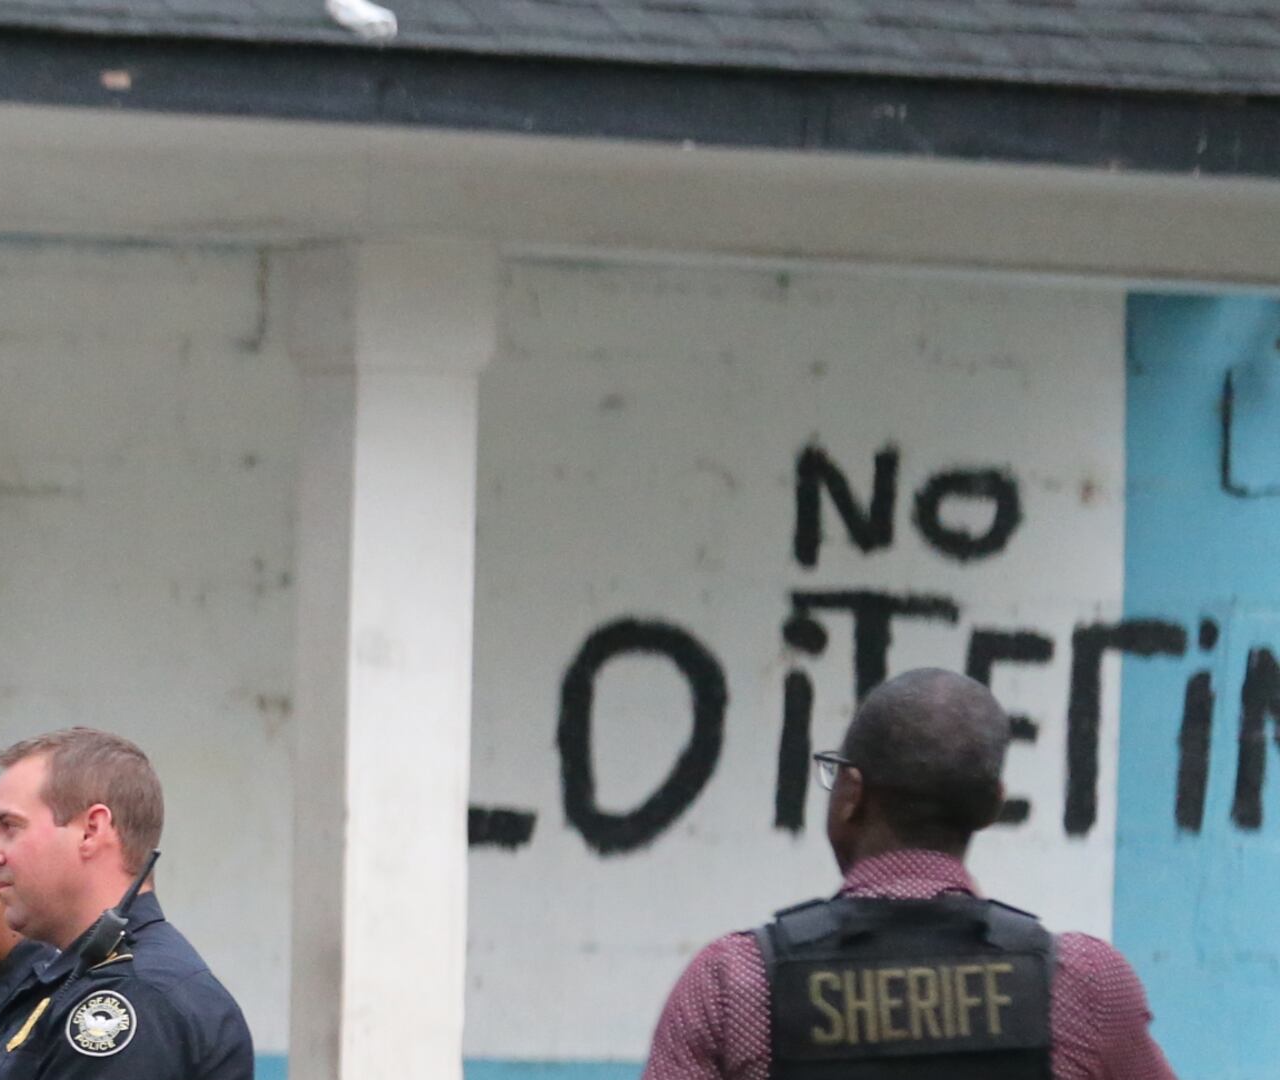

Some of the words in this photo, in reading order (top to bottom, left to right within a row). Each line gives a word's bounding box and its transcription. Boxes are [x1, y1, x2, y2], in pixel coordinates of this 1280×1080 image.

[73, 1004, 87, 1024] CITY
[88, 996, 104, 1007] OF
[809, 962, 1014, 1044] SHERIFF
[74, 1034, 116, 1051] POLICE
